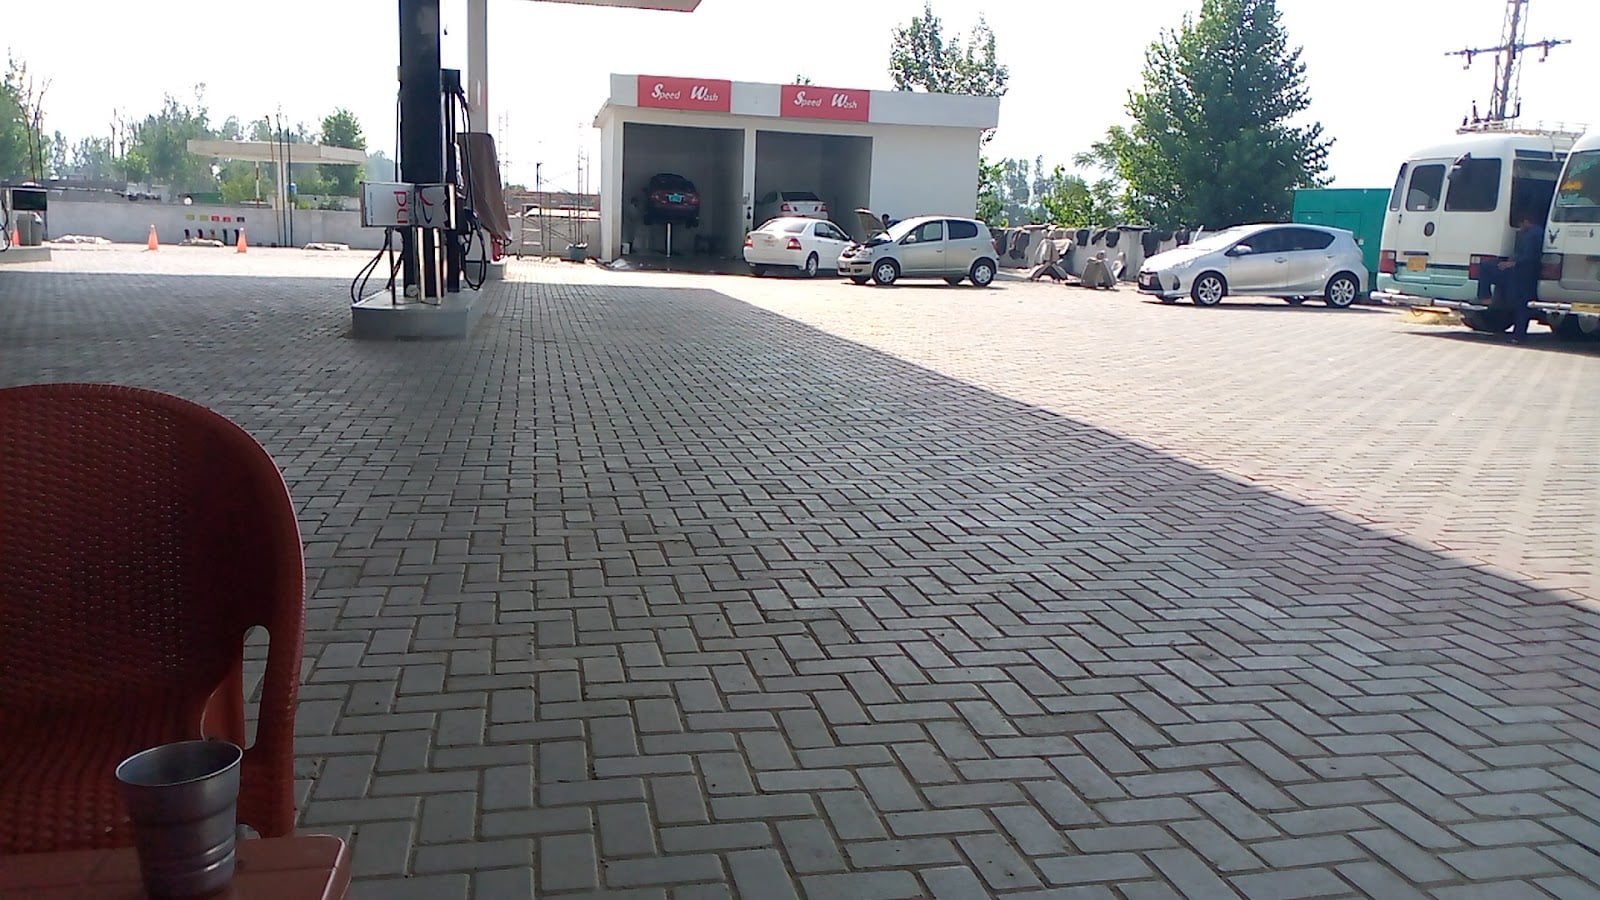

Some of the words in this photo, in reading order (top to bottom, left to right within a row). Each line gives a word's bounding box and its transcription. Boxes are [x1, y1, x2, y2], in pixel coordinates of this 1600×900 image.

[651, 83, 681, 101] Speed
[690, 86, 719, 102] Wash
[793, 90, 823, 108] Speed
[831, 93, 858, 109] Wash
